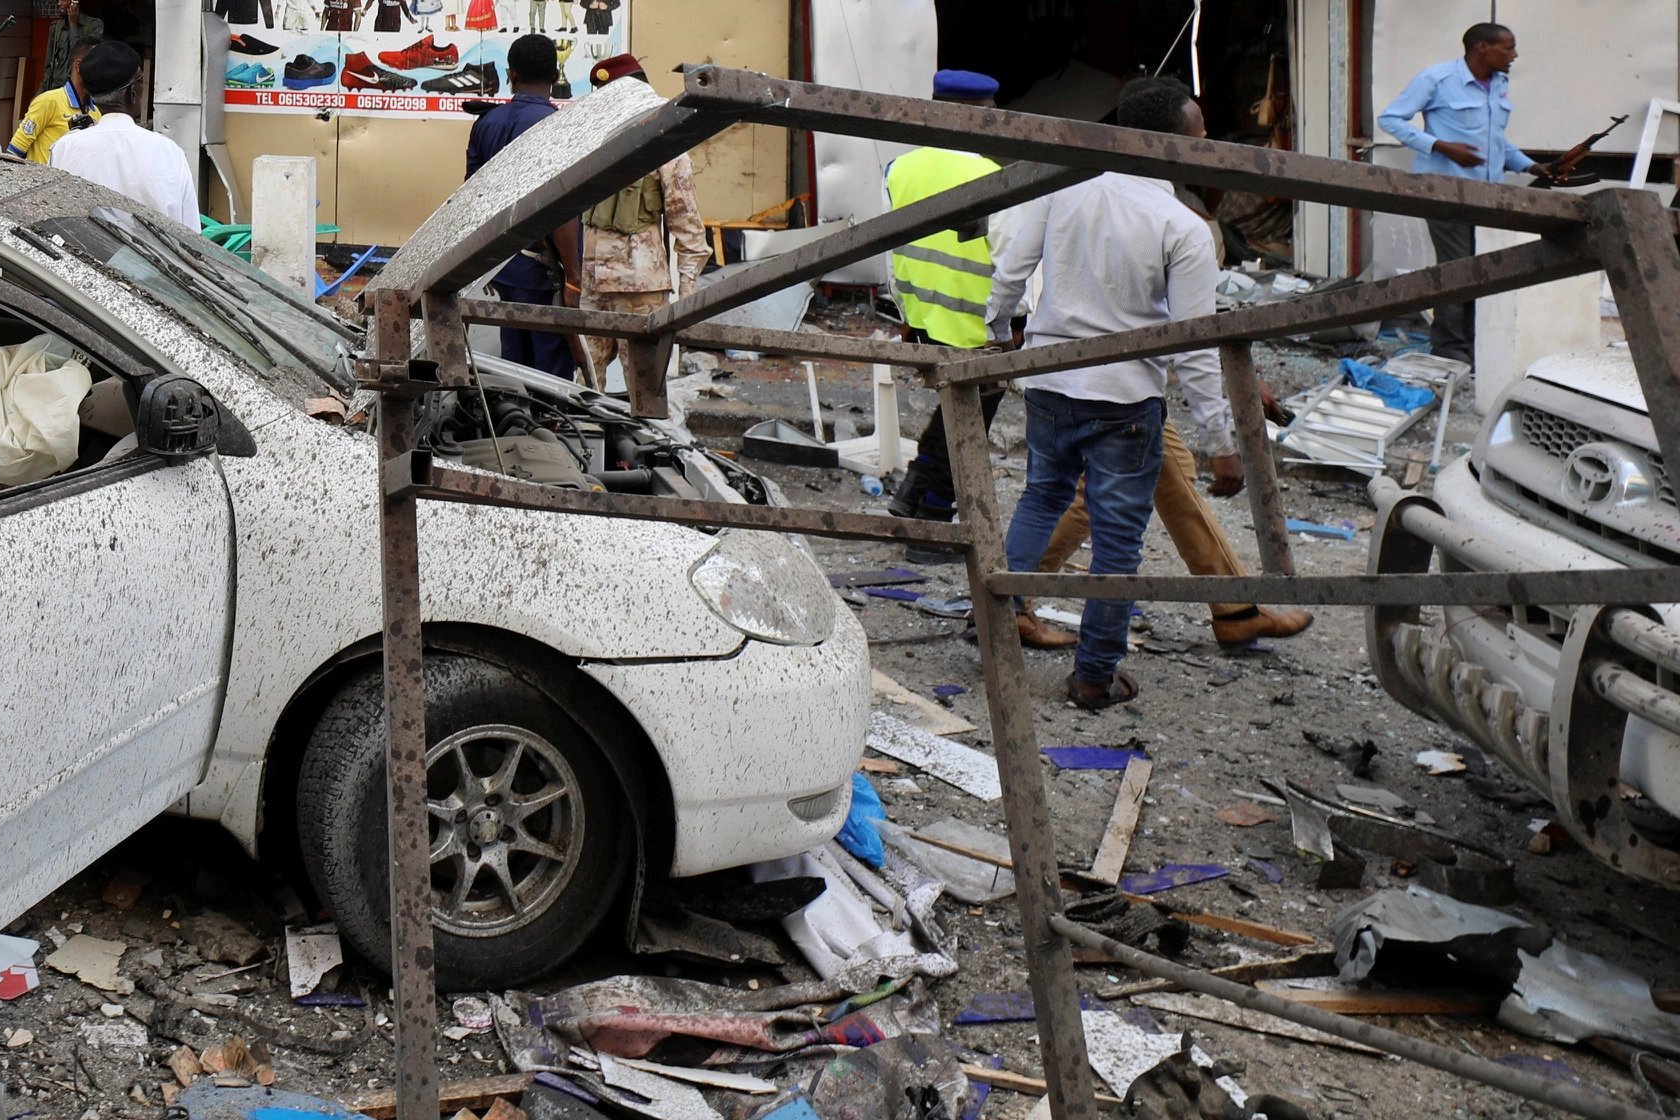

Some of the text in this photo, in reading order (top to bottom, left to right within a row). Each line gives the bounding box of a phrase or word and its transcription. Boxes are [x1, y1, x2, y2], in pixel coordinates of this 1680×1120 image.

[255, 92, 274, 105] TEL
[278, 93, 345, 107] 0615302330
[357, 95, 427, 110] 0615702098
